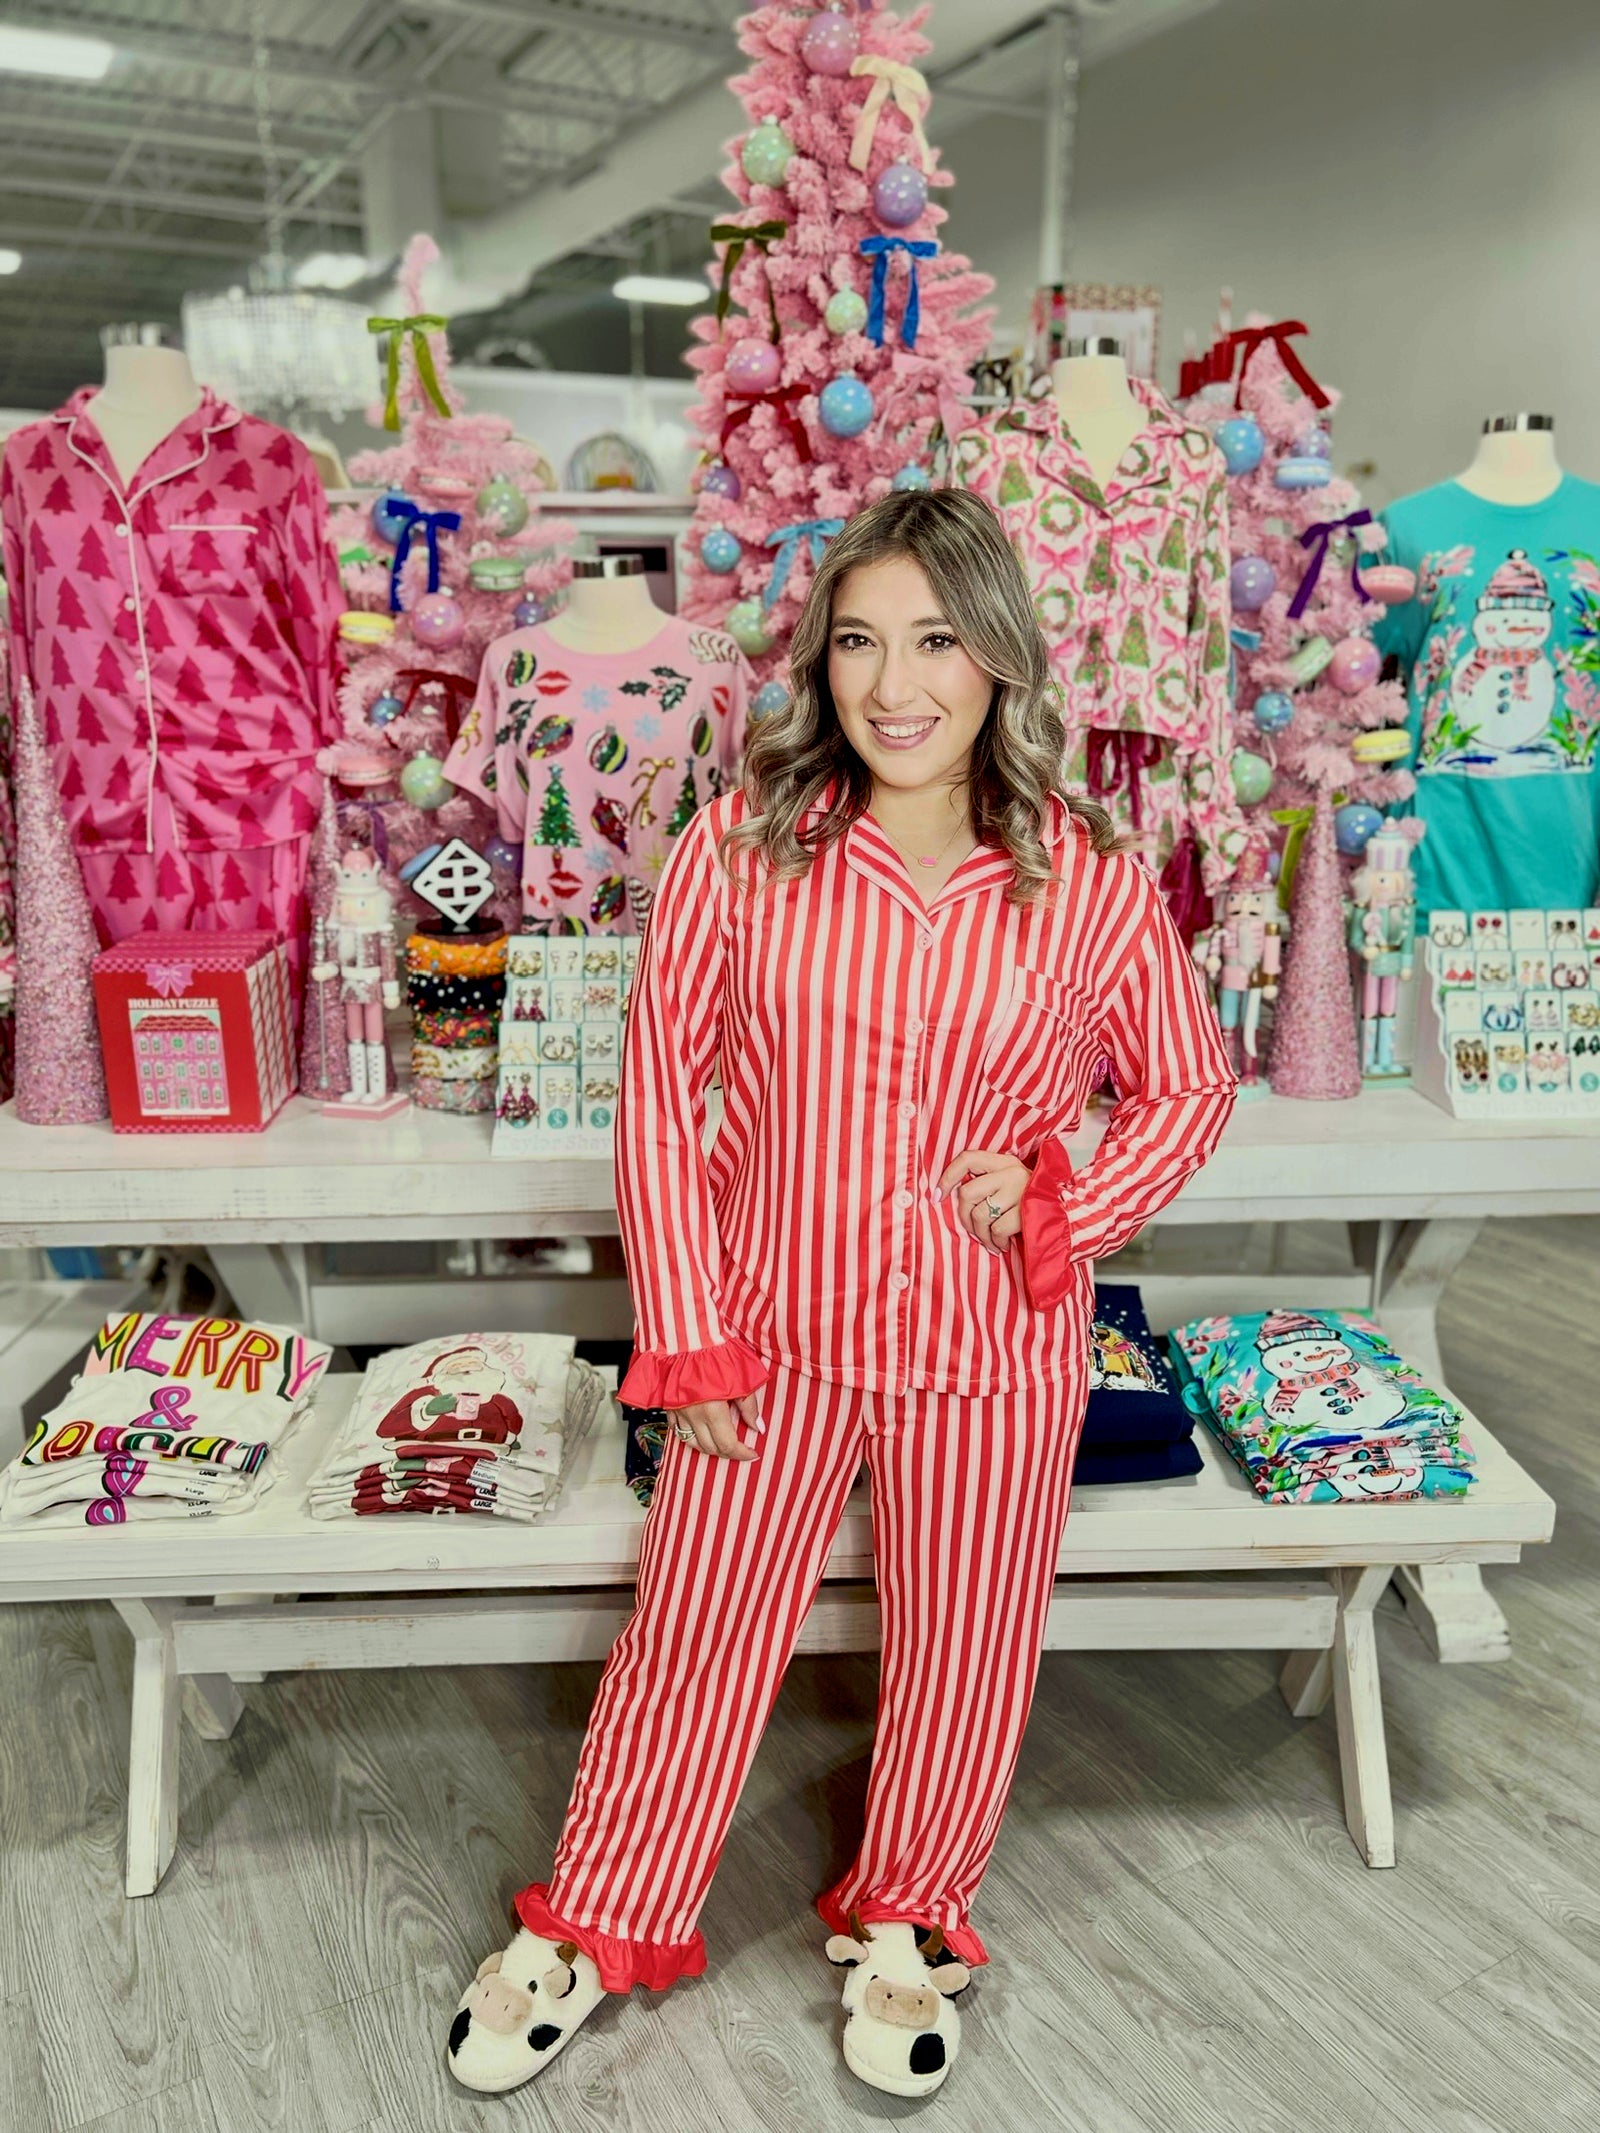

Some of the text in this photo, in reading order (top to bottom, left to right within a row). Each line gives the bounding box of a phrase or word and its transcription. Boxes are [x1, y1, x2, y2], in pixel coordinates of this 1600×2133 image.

[128, 998, 219, 1009] HOLIDAY PUZZLE
[565, 1134, 611, 1154] Shay
[82, 1313, 329, 1402] MERRY
[129, 1385, 198, 1432] &
[473, 1470, 496, 1480] Medium
[474, 1500, 493, 1508] LARGE
